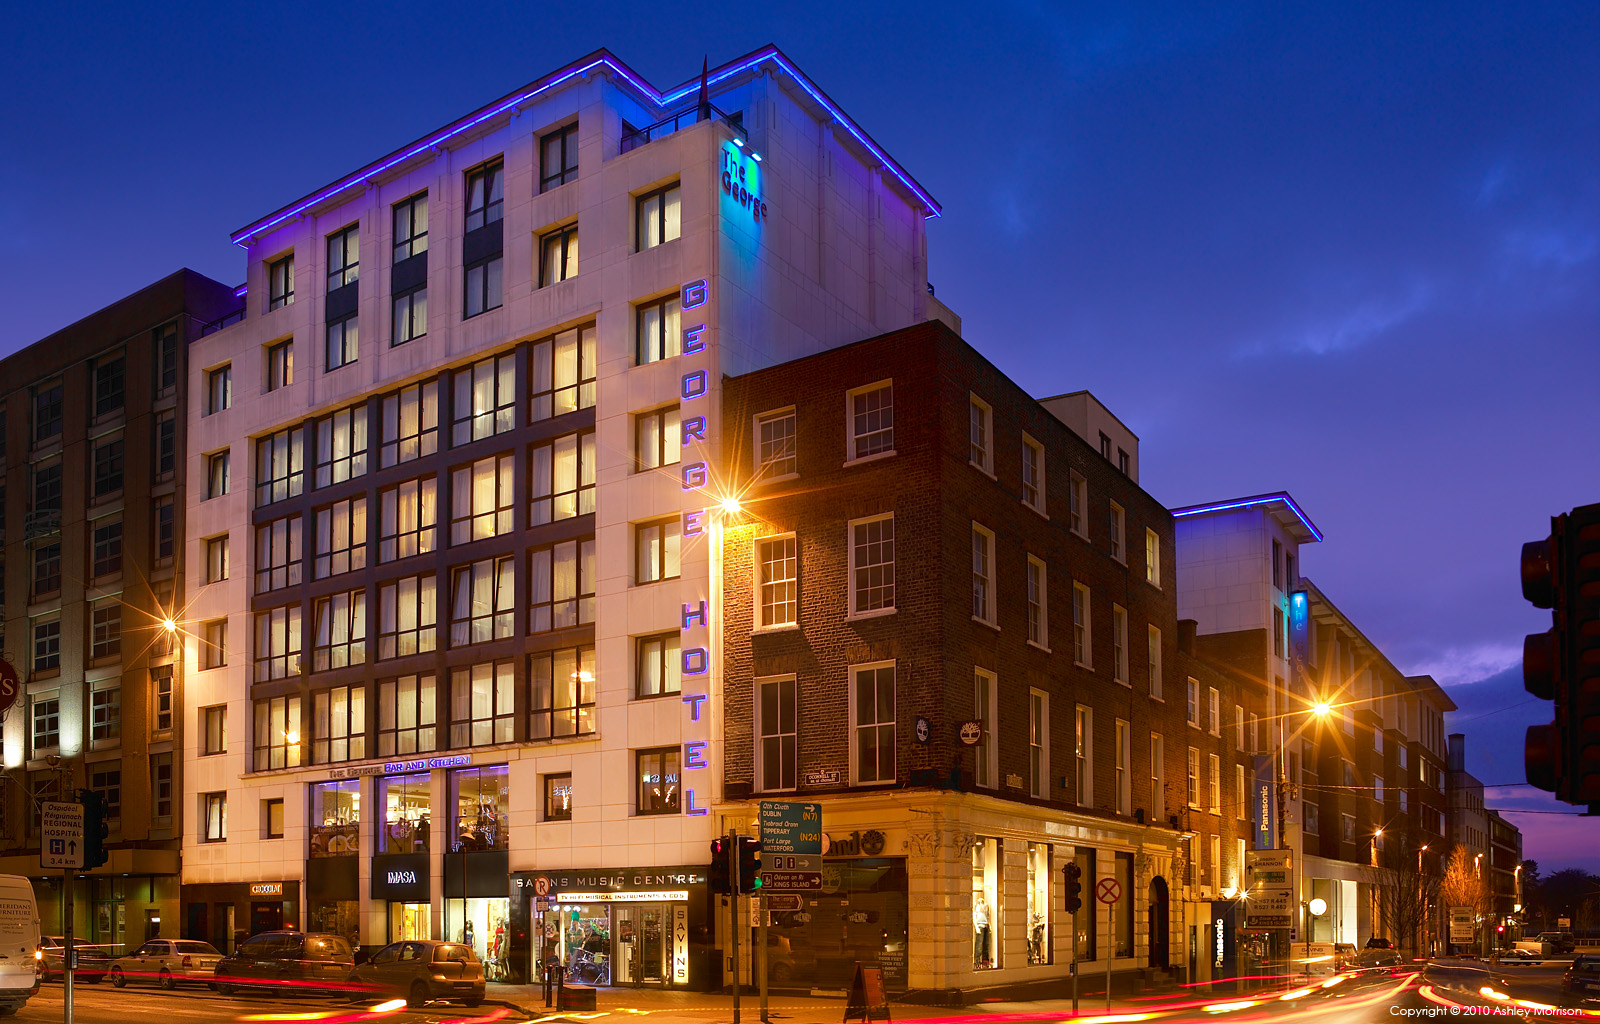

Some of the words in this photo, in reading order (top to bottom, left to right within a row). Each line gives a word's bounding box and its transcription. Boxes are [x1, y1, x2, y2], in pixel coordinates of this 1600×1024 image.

[722, 147, 745, 183] The
[722, 171, 767, 223] George
[681, 278, 708, 538] GEORGE
[681, 600, 708, 817] HOTEL
[384, 762, 404, 773] BAR
[405, 760, 426, 771] AND
[428, 756, 470, 768] KITCHEN
[1260, 785, 1269, 831] Panasonic
[43, 819, 82, 828] REGIONAL
[44, 829, 81, 837] HOSPITAL
[763, 827, 790, 835] TIPPERARY
[800, 832, 820, 842] (N24)
[50, 857, 62, 865] 3.4
[577, 876, 625, 886] MUSIC
[633, 874, 698, 885] CENTRE
[676, 910, 685, 978] SAVINS
[1215, 918, 1224, 968] Panasonic
